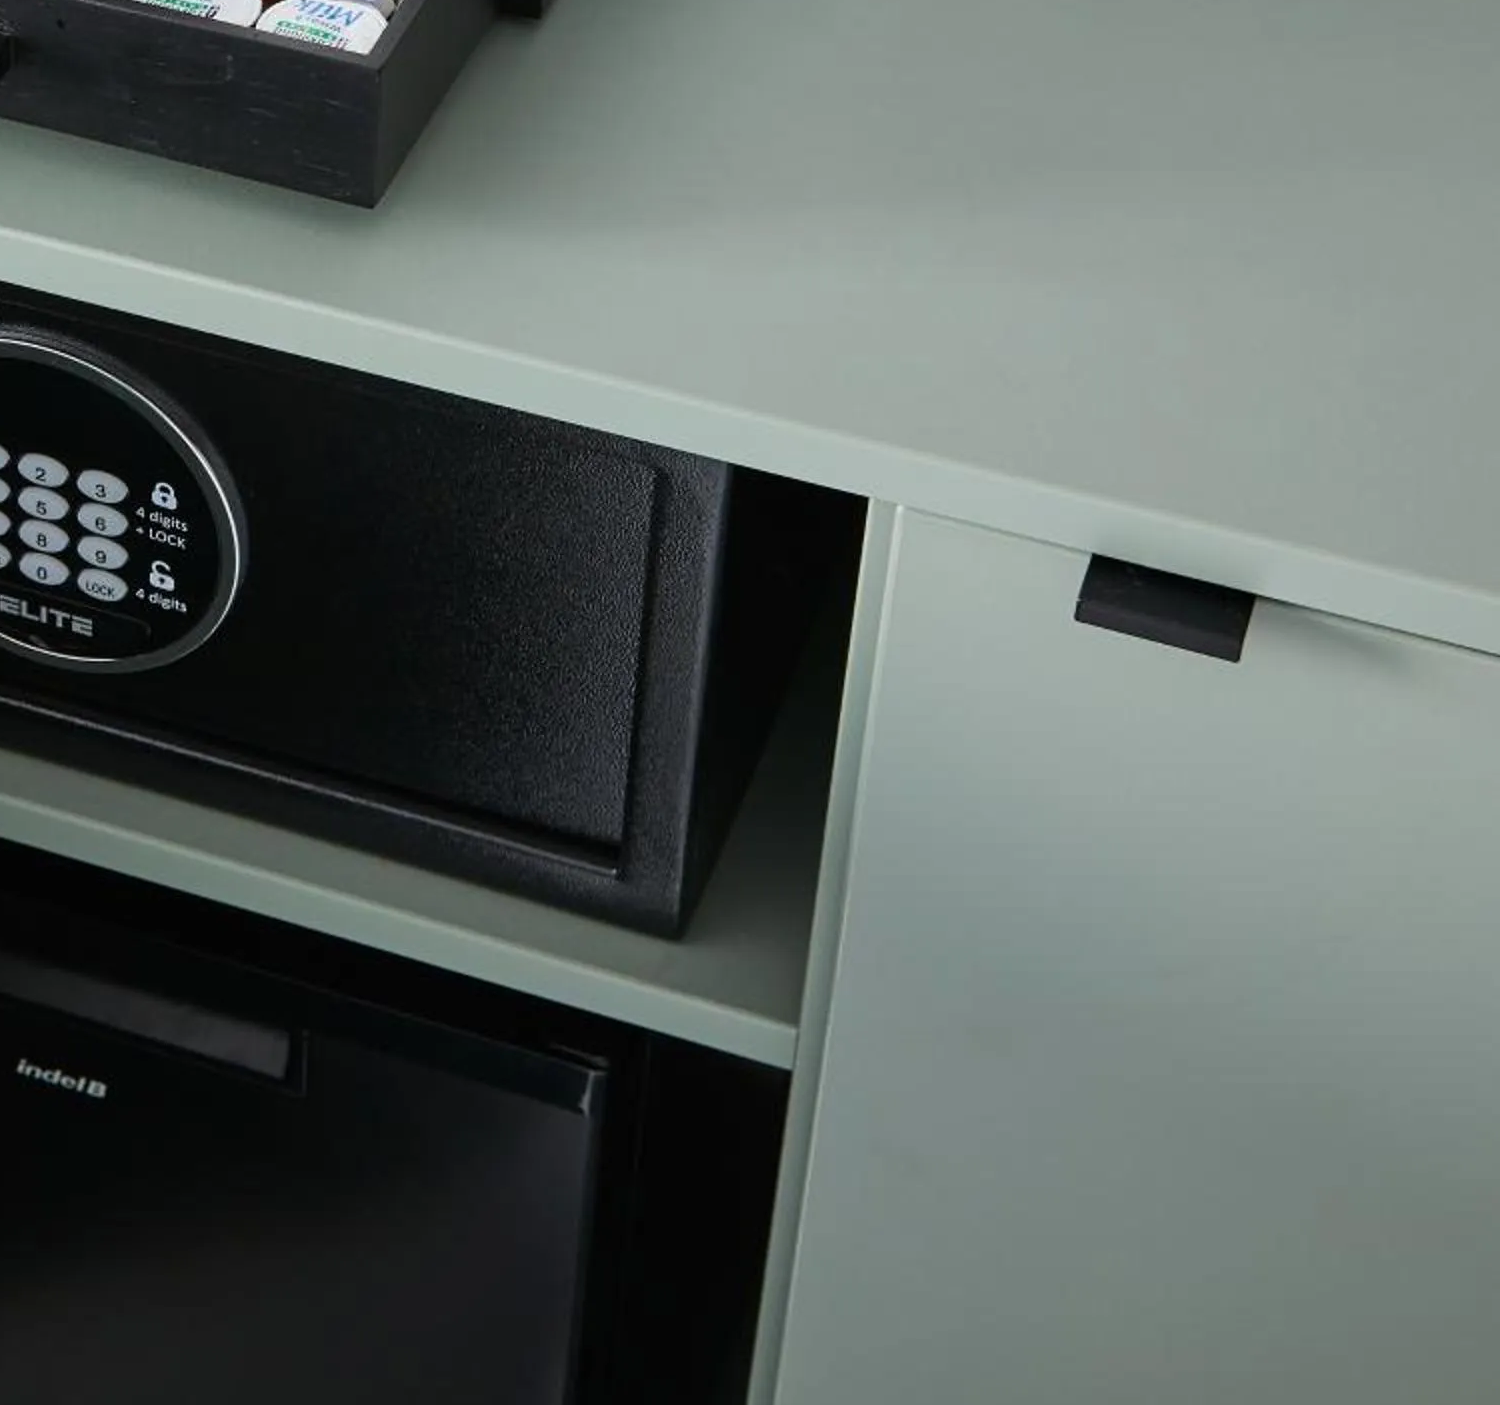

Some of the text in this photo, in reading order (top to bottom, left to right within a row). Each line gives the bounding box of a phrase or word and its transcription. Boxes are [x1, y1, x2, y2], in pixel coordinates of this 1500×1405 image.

[35, 467, 46, 482] 2
[95, 484, 106, 498] 3
[36, 500, 47, 515] 5
[95, 518, 106, 531] 6
[136, 506, 188, 532] 4 digits
[36, 533, 47, 547] 8
[95, 550, 106, 564] 9
[149, 528, 186, 550] LOCK
[36, 566, 47, 580] 0
[85, 581, 115, 599] LOCK
[135, 588, 187, 613] 4 digits
